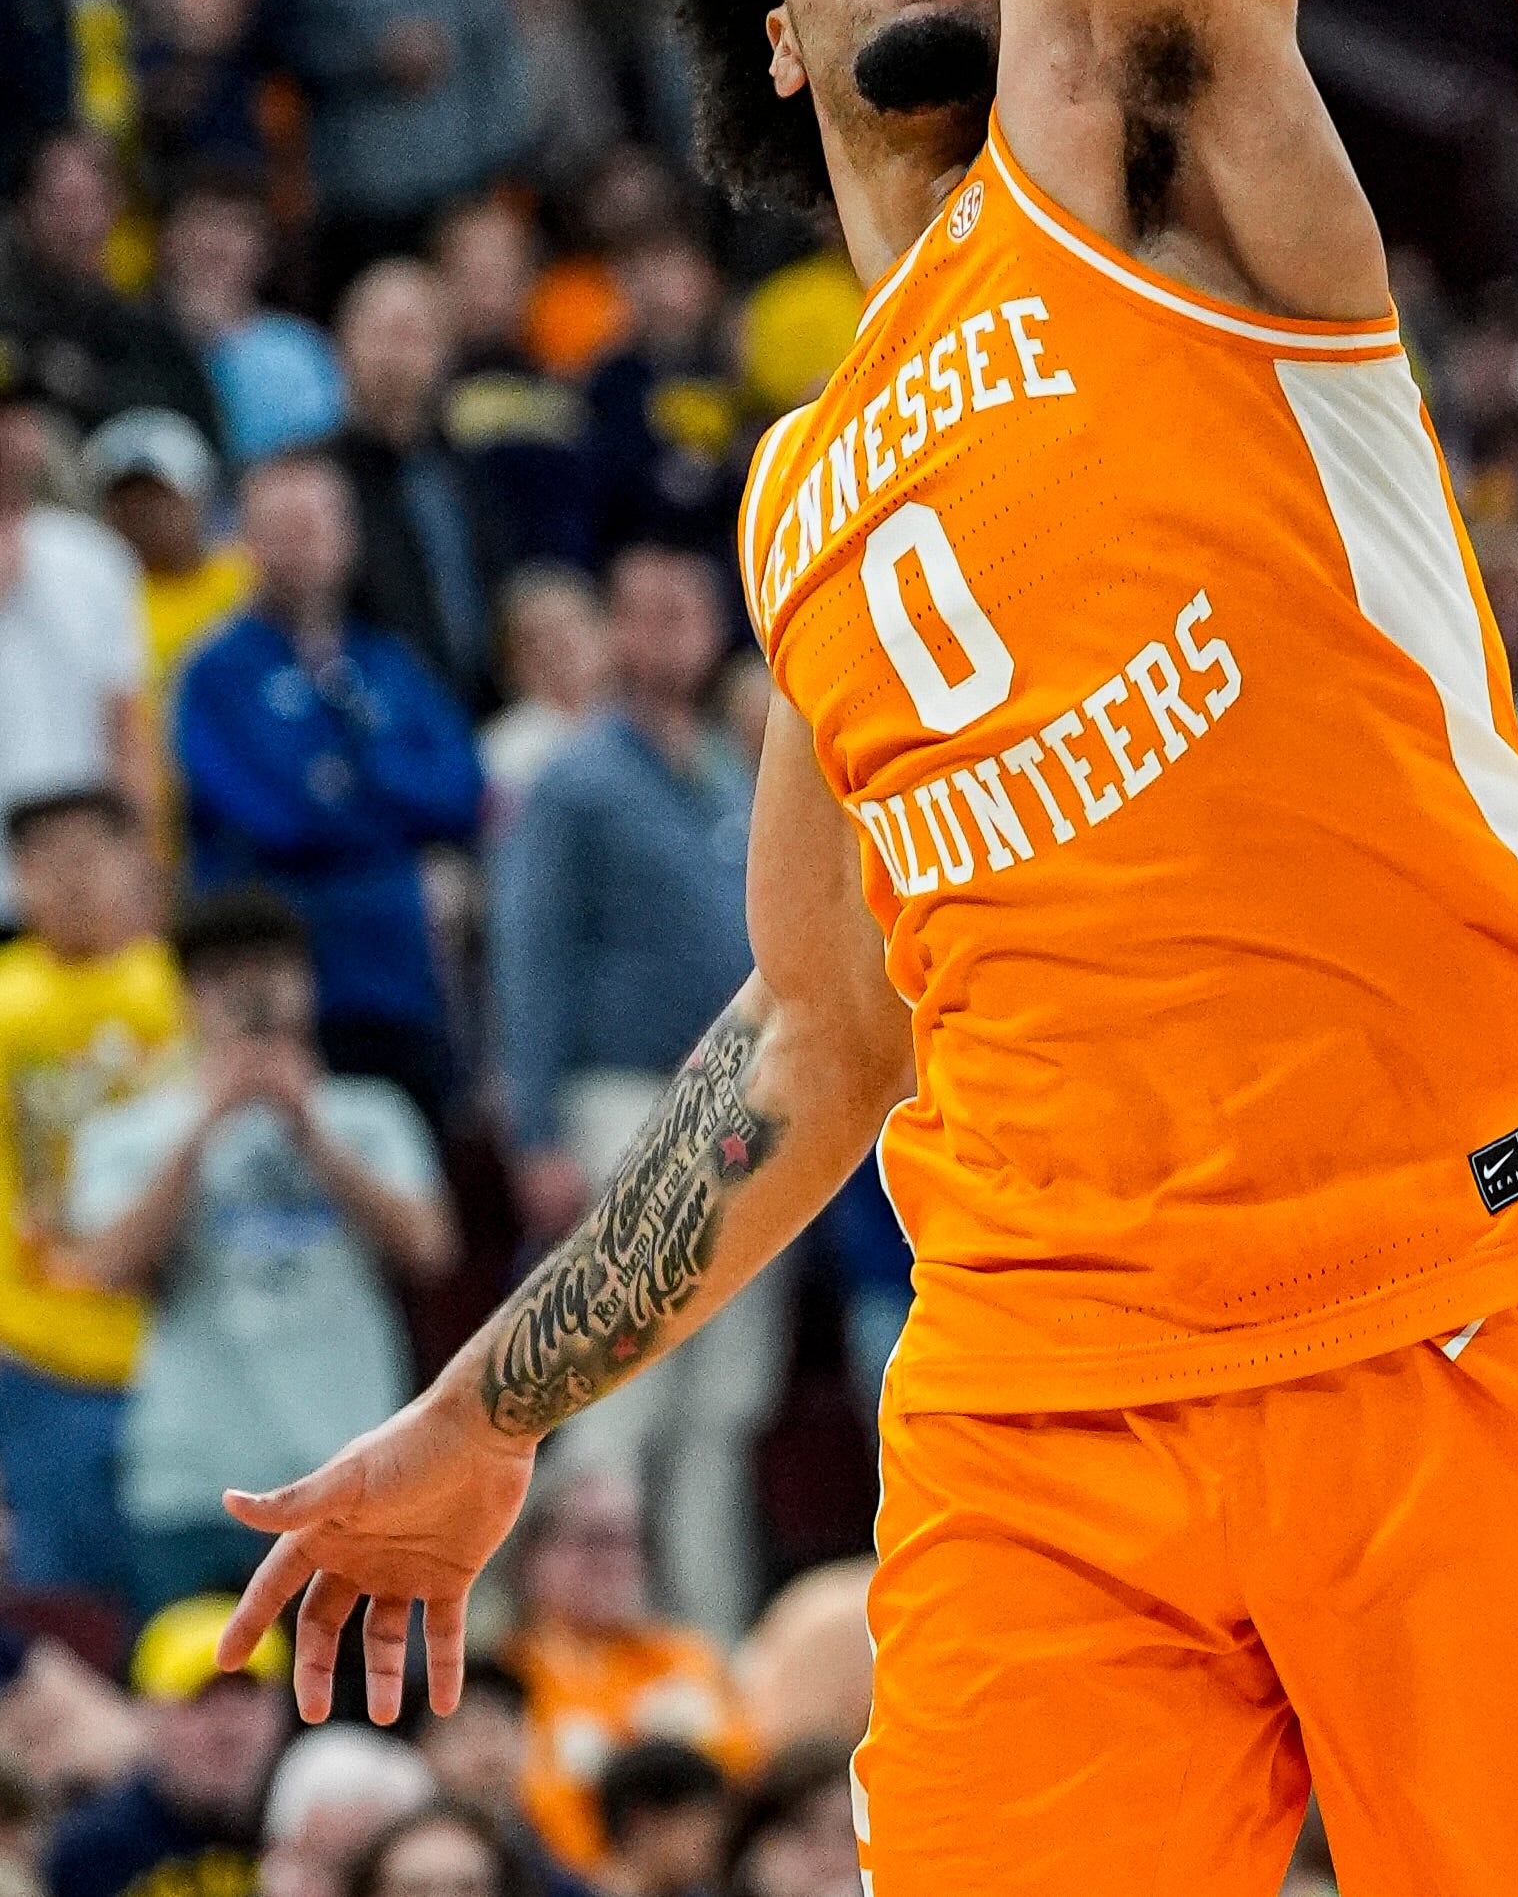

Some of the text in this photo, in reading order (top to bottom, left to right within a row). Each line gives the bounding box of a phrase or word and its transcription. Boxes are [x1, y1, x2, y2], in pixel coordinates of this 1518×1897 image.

[949, 184, 982, 239] SEC
[859, 500, 1016, 735] 0
[842, 588, 1243, 898] OLUNTEERS
